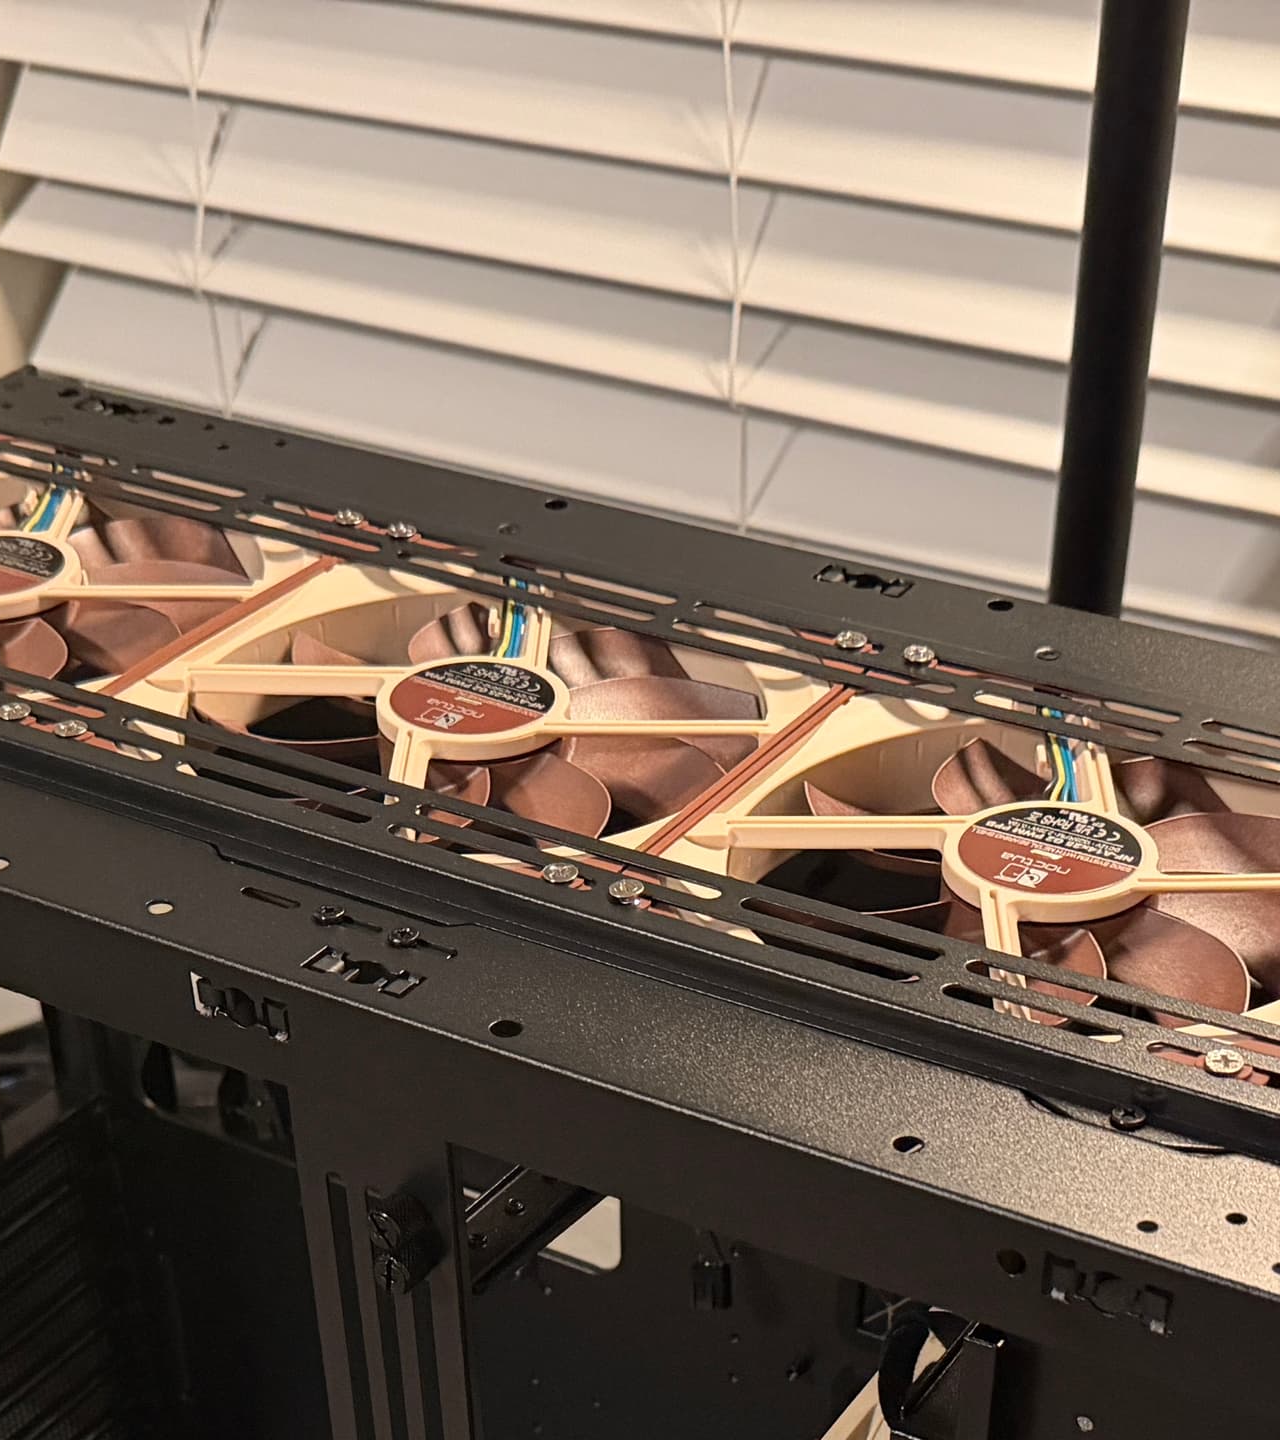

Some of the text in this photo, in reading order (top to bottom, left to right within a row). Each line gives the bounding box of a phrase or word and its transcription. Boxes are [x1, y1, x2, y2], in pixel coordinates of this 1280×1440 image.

[426, 697, 485, 719] noctua
[1040, 814, 1074, 831] RoHS
[1000, 851, 1071, 875] noctua
